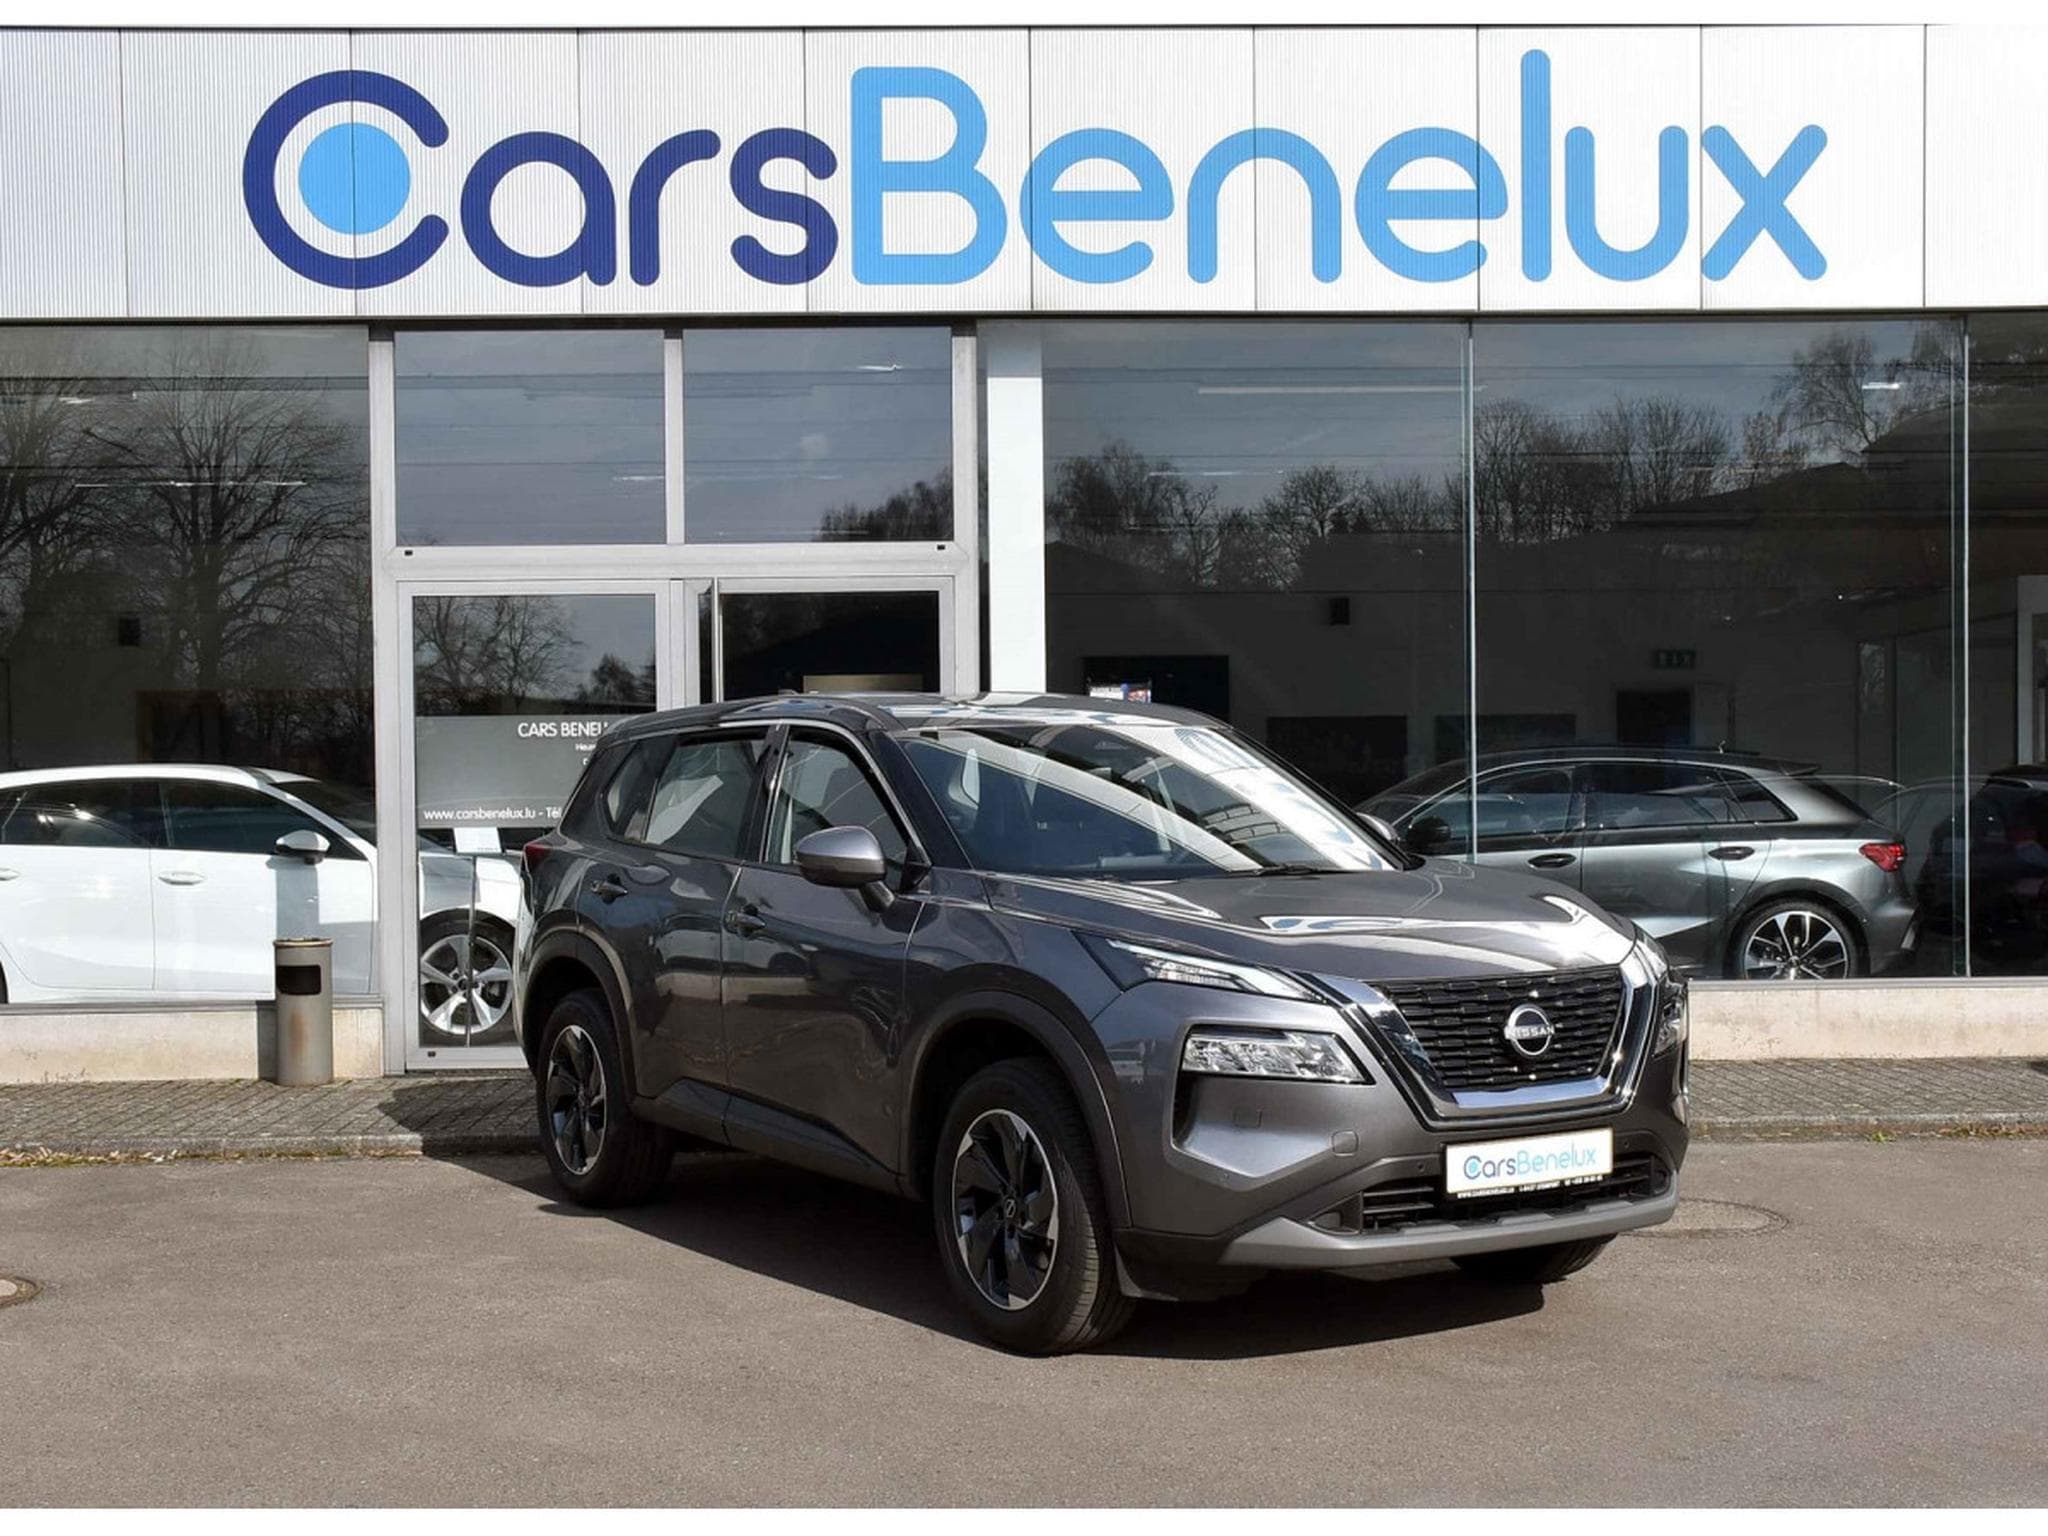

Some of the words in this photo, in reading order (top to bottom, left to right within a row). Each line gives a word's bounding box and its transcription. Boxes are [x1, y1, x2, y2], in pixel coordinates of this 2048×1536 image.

[245, 50, 1827, 287] CarsBenelux
[517, 721, 558, 738] CARS
[560, 721, 608, 737] BENEL
[423, 806, 536, 820] www.carsbenelux.lu
[1504, 1024, 1555, 1039] NISSAN
[1463, 1142, 1597, 1180] CarsBenelux
